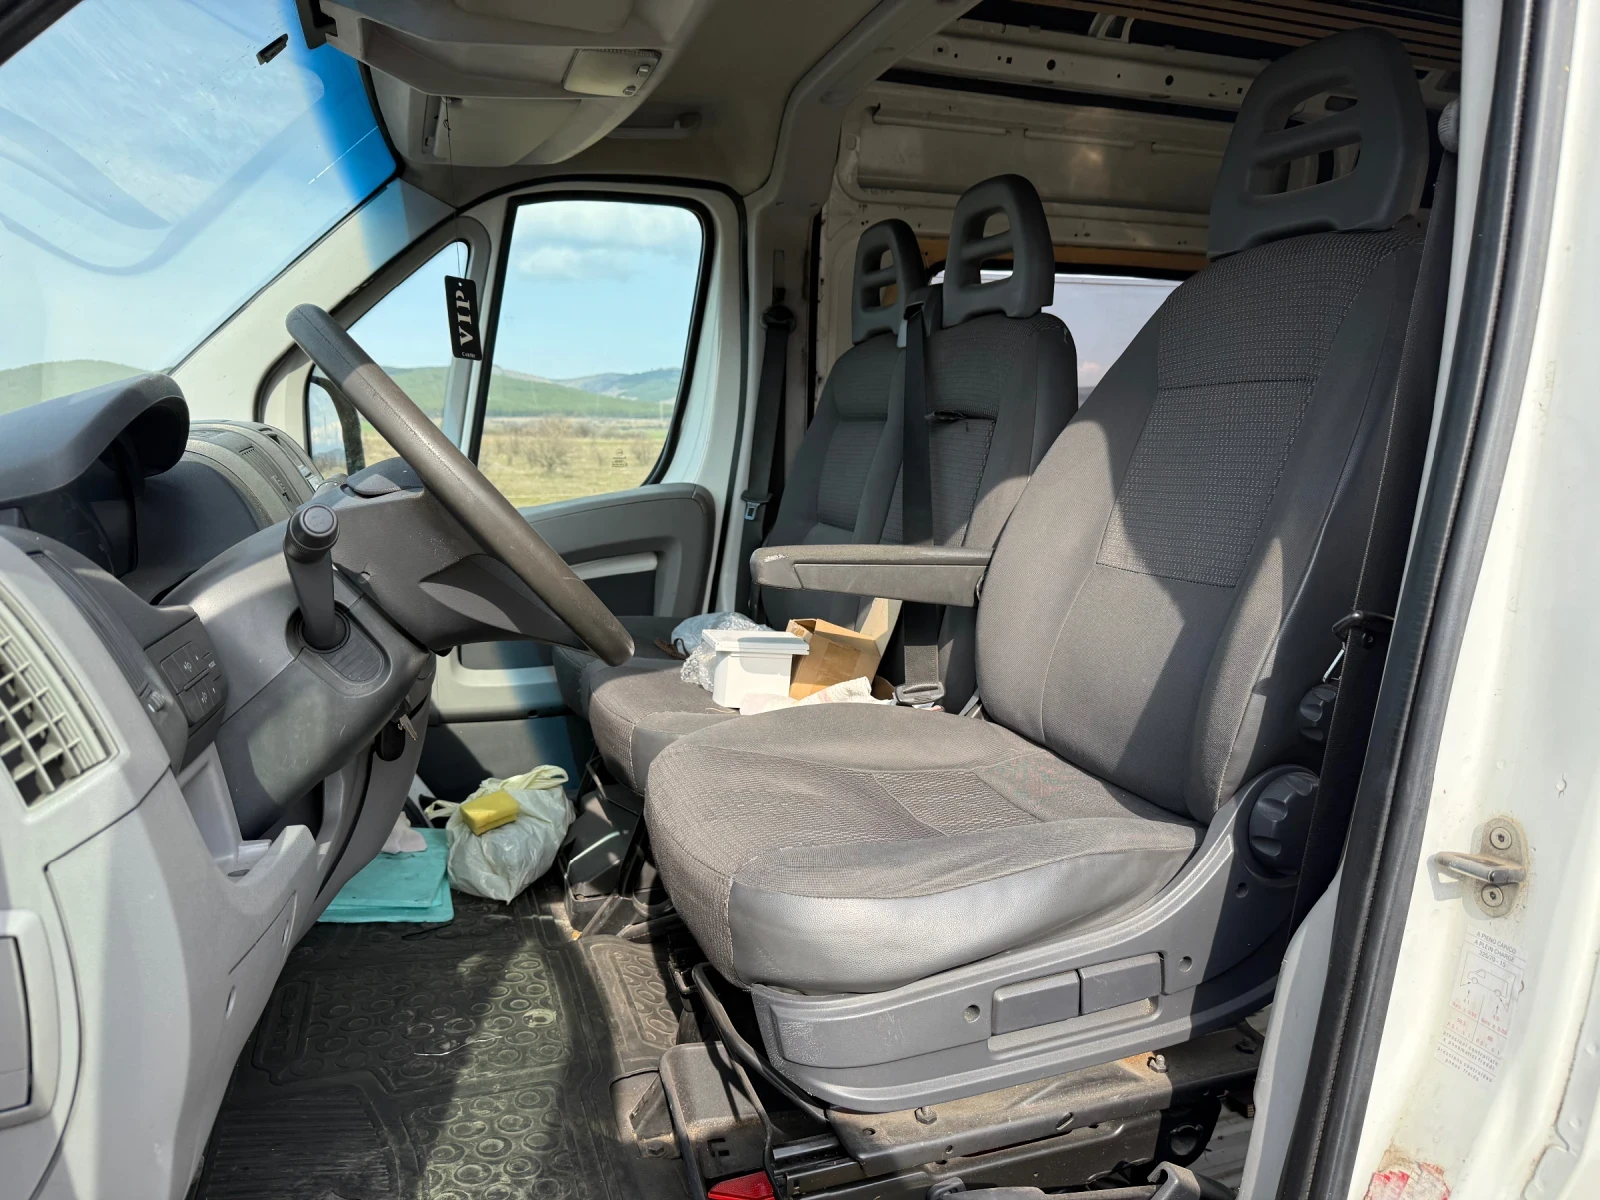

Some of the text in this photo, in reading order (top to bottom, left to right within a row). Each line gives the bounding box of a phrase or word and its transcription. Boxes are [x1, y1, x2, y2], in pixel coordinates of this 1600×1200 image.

[455, 289, 474, 346] VIP
[1479, 941, 1494, 953] PLEIN
[1494, 948, 1515, 963] CHARGE
[1481, 933, 1497, 945] PIENO
[1497, 940, 1517, 955] CARICO
